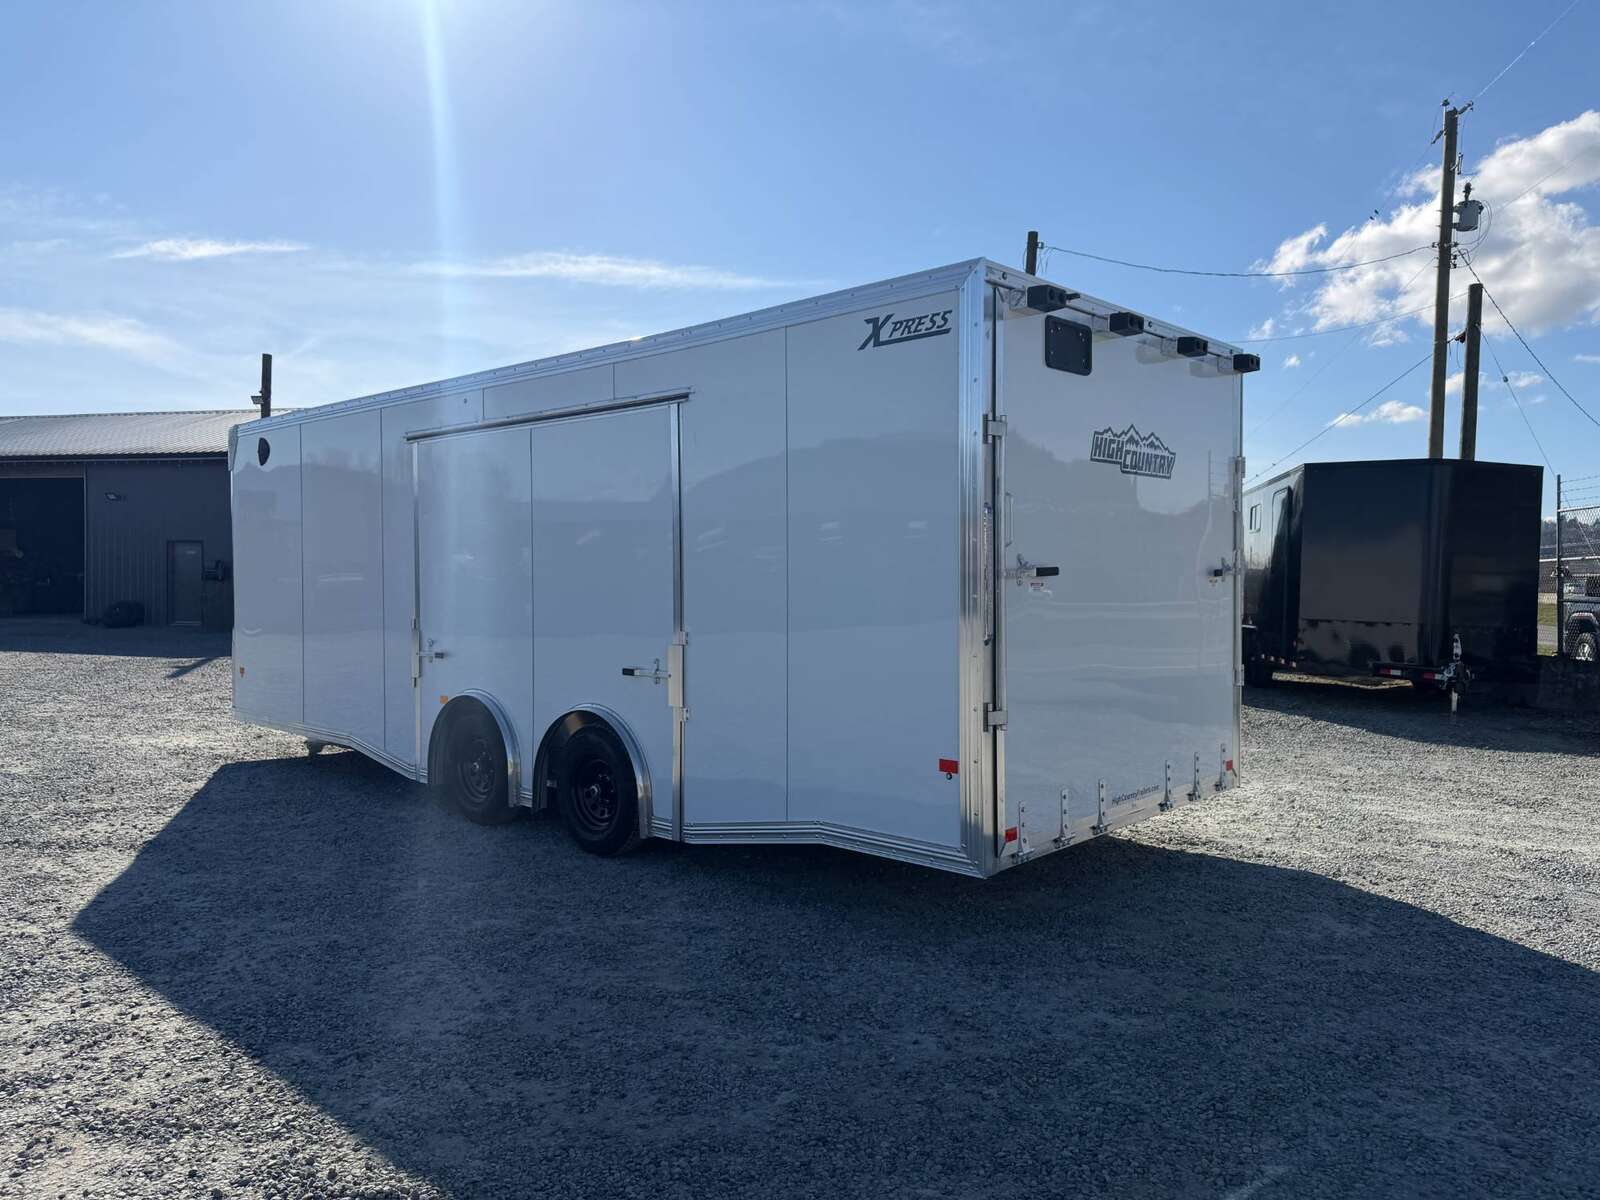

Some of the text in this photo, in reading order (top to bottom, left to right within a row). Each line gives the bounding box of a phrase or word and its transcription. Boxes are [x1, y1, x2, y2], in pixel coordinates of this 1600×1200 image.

[857, 309, 953, 351] XPRESS
[1092, 435, 1125, 460] HIGH
[1122, 448, 1175, 475] COUNTRY
